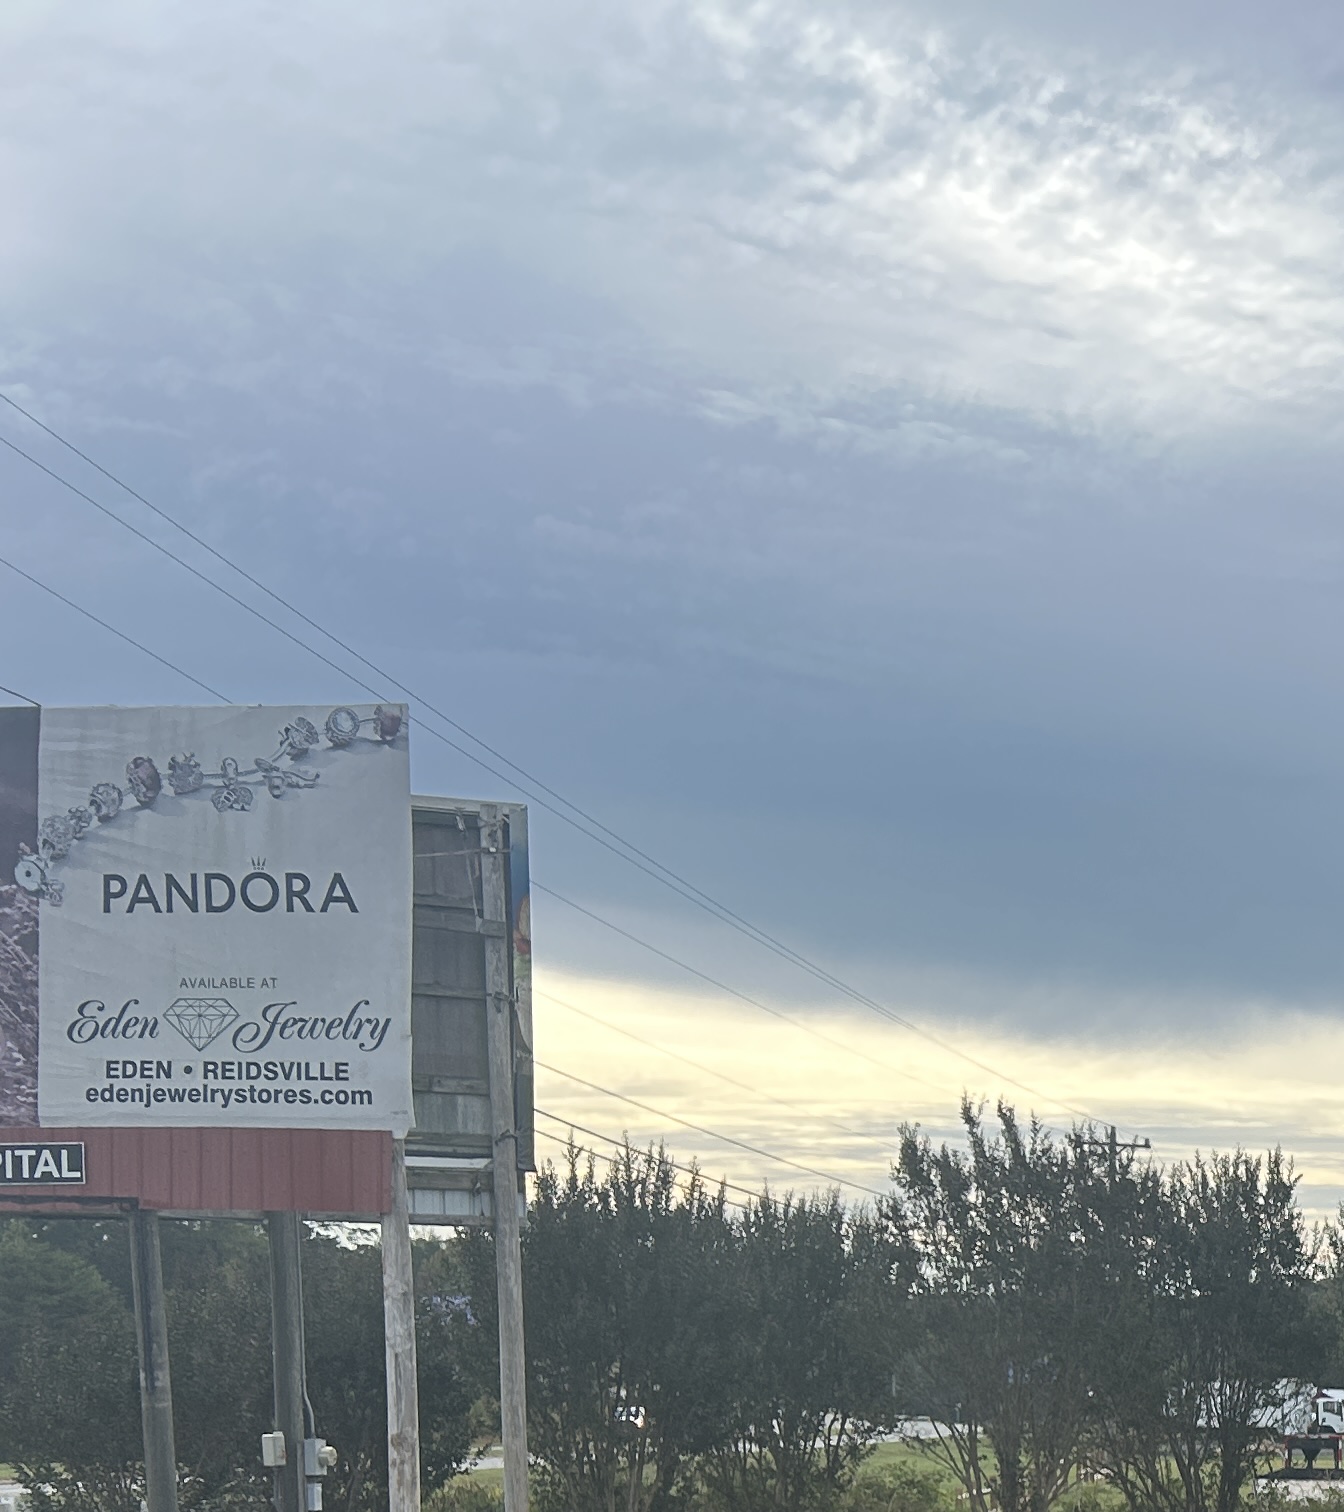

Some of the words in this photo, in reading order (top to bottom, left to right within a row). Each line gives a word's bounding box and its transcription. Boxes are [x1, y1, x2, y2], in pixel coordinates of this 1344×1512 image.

[102, 872, 360, 914] PANDORA
[179, 976, 256, 990] AVAILABLE
[260, 976, 279, 989] AT
[66, 999, 160, 1044] Eden
[231, 999, 393, 1054] Jewelry
[105, 1060, 173, 1080] EDEN
[202, 1061, 350, 1082] REIDSVILLE
[85, 1083, 373, 1108] edenjewelrystores.com
[0, 1148, 82, 1179] ITAL
